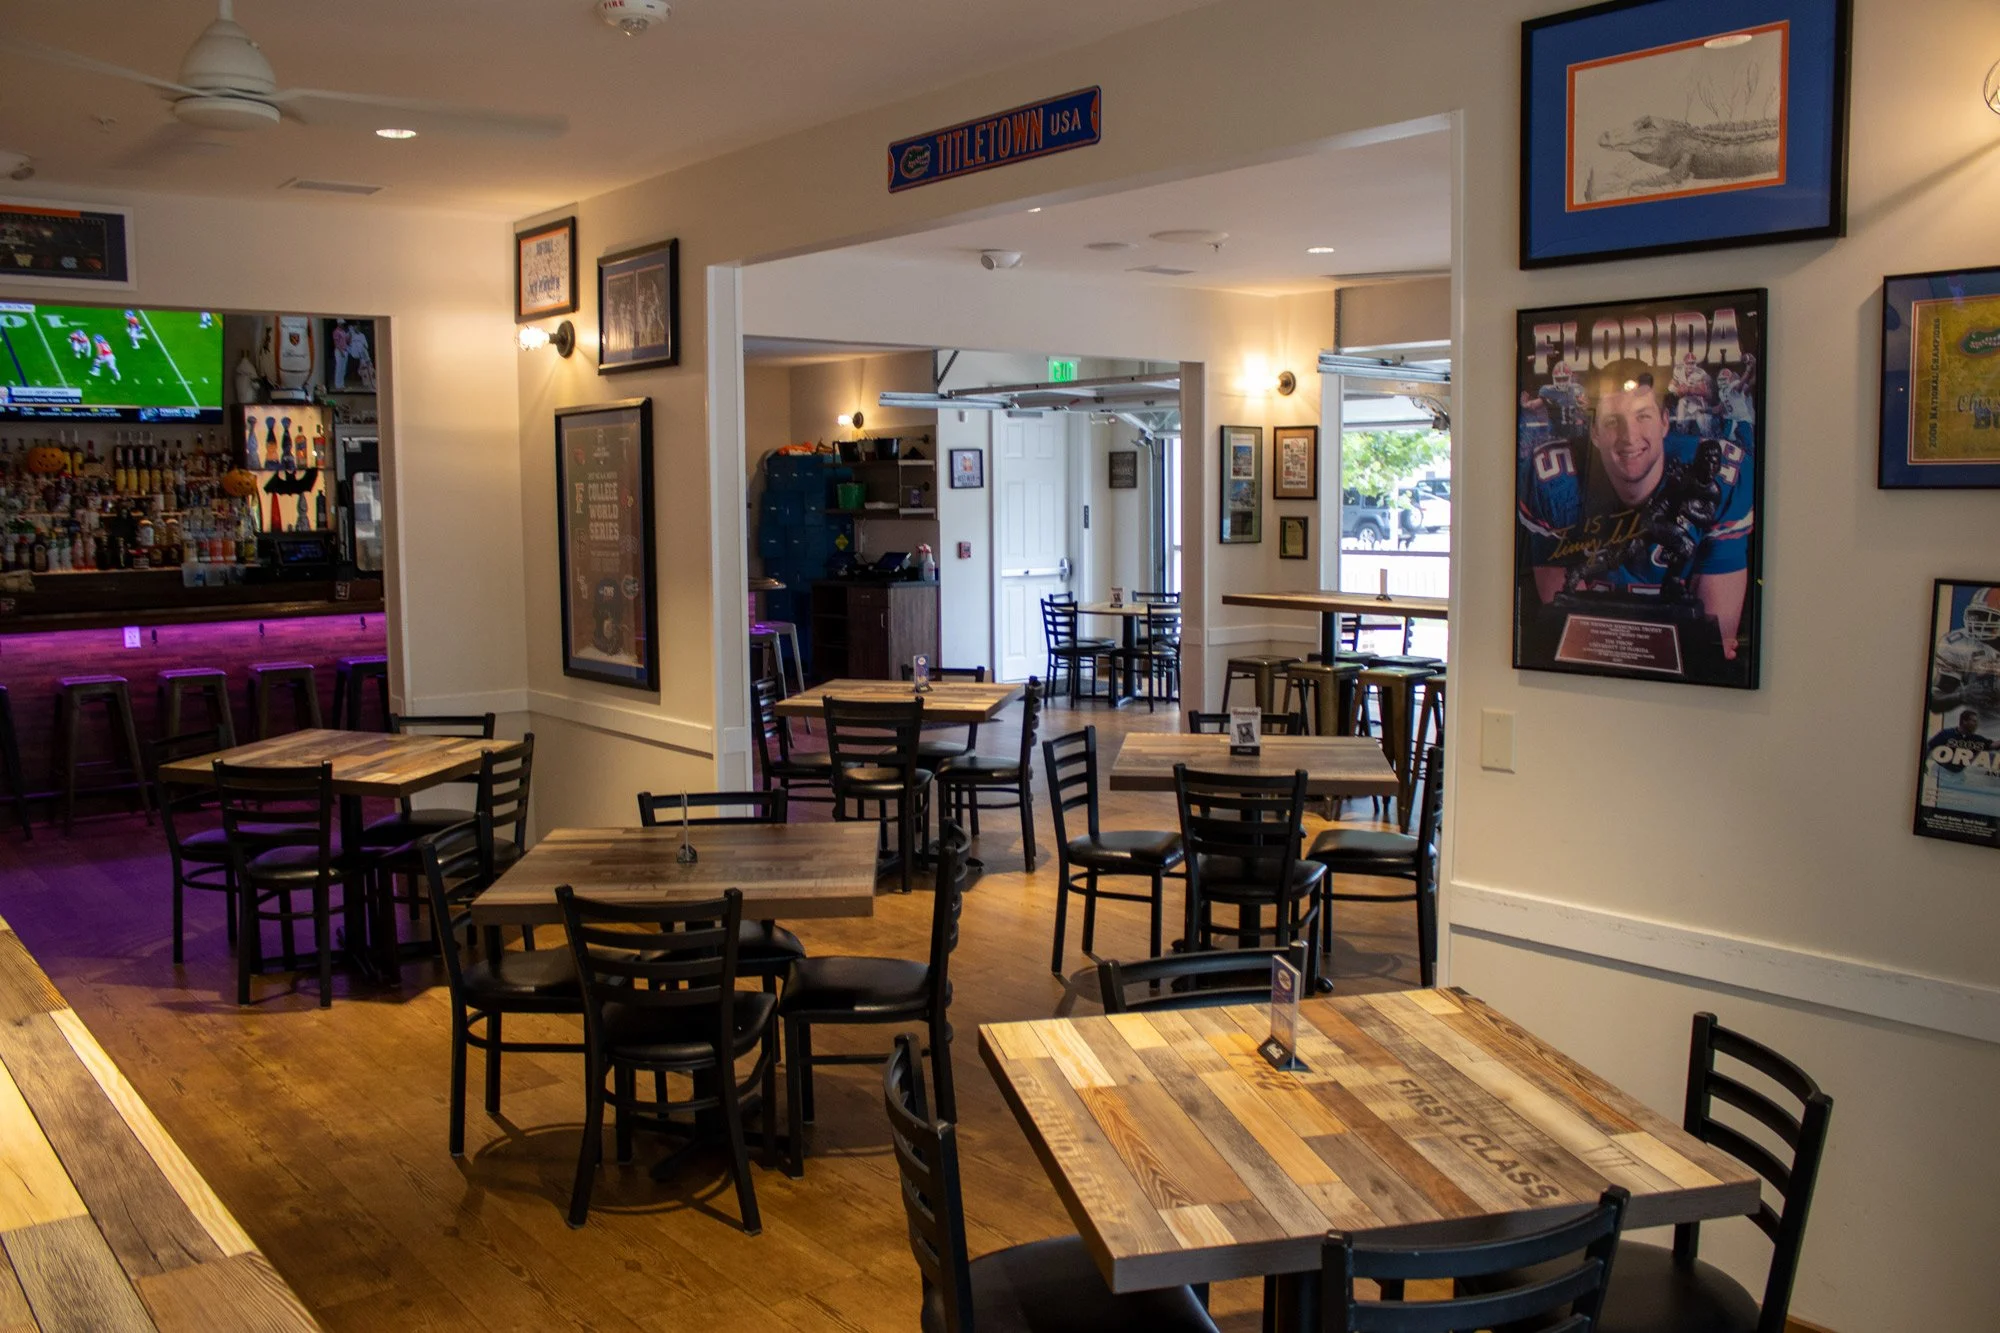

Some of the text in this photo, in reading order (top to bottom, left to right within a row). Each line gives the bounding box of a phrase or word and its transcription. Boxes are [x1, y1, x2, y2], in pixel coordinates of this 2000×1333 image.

[603, 0, 625, 10] FIRE
[936, 107, 1082, 174] TITLETOWN USA
[1533, 308, 1743, 374] FLORIDA
[1053, 362, 1074, 382] EXIT
[588, 482, 619, 501] COLLEGE
[588, 504, 619, 519] WORLD
[589, 522, 620, 541] SERIES
[1387, 1079, 1560, 1199] FIRST CLASS
